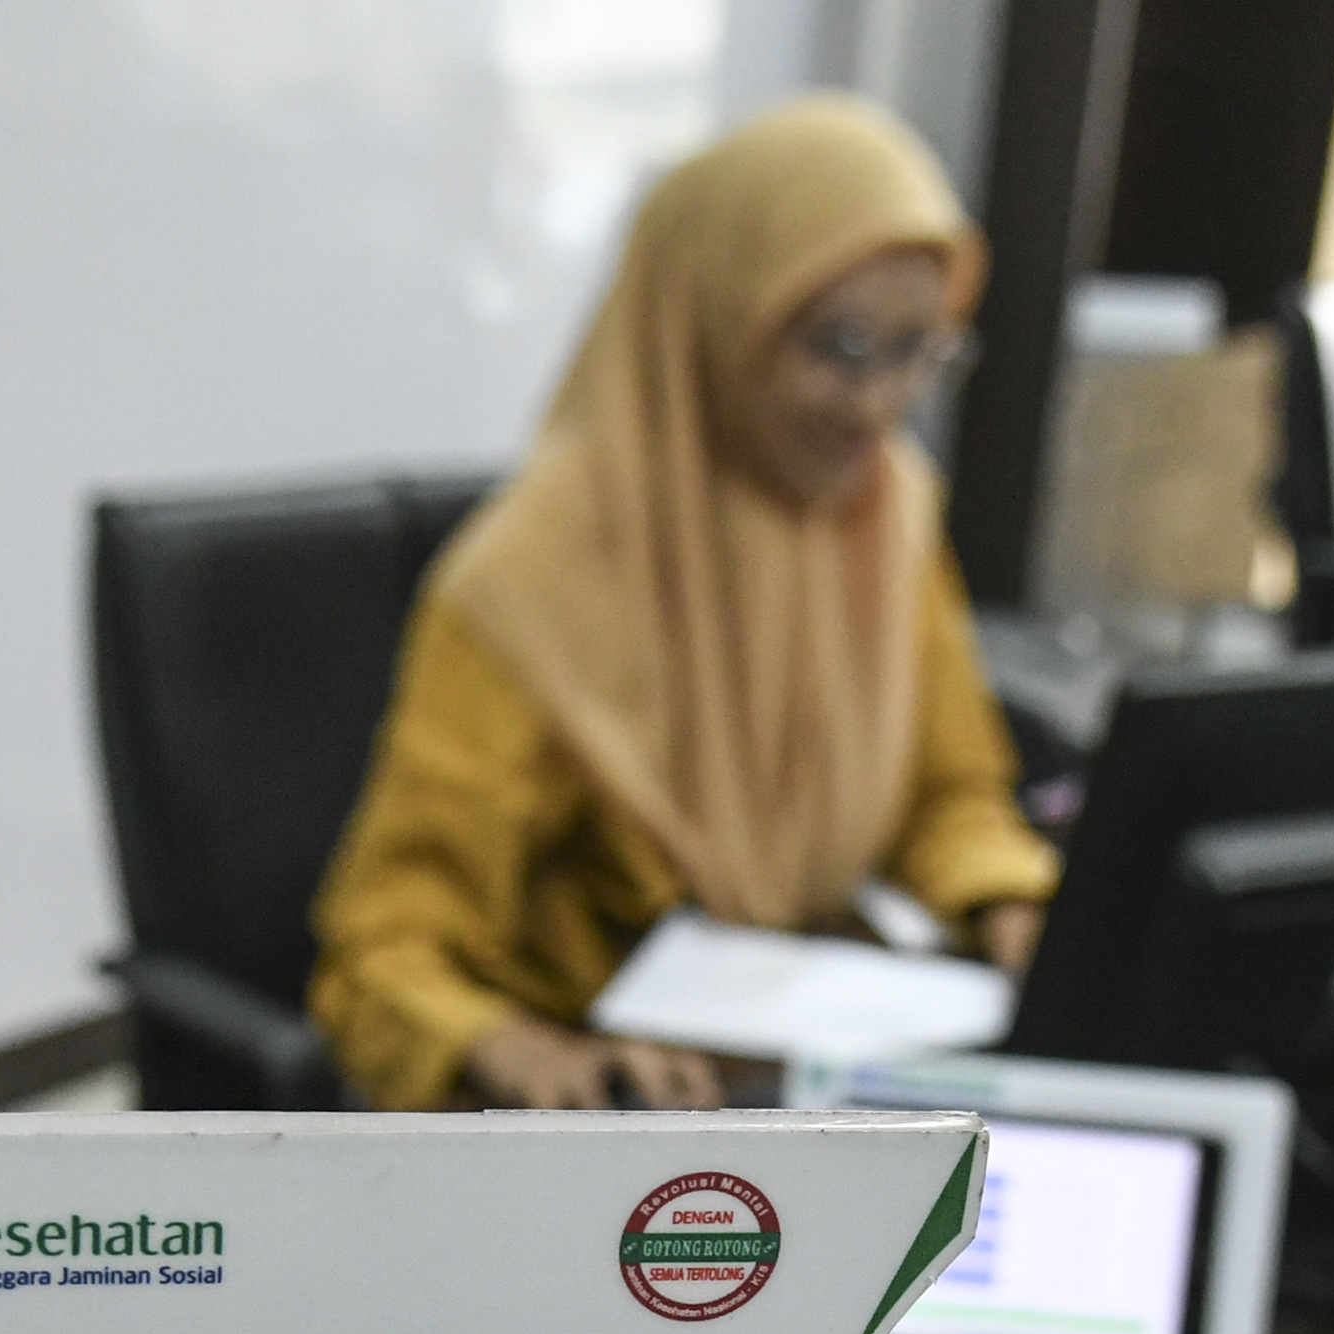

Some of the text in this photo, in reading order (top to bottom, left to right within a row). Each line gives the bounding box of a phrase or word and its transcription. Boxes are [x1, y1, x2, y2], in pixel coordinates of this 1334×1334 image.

[640, 1176, 769, 1217] Revolusi Mental
[672, 1211, 734, 1225] DENGAN
[643, 1240, 761, 1256] GOTONG ROYONG
[57, 1266, 151, 1286] Jaminan
[159, 1266, 222, 1285] Sosial
[649, 1267, 744, 1281] SEMUA TERTOLONG
